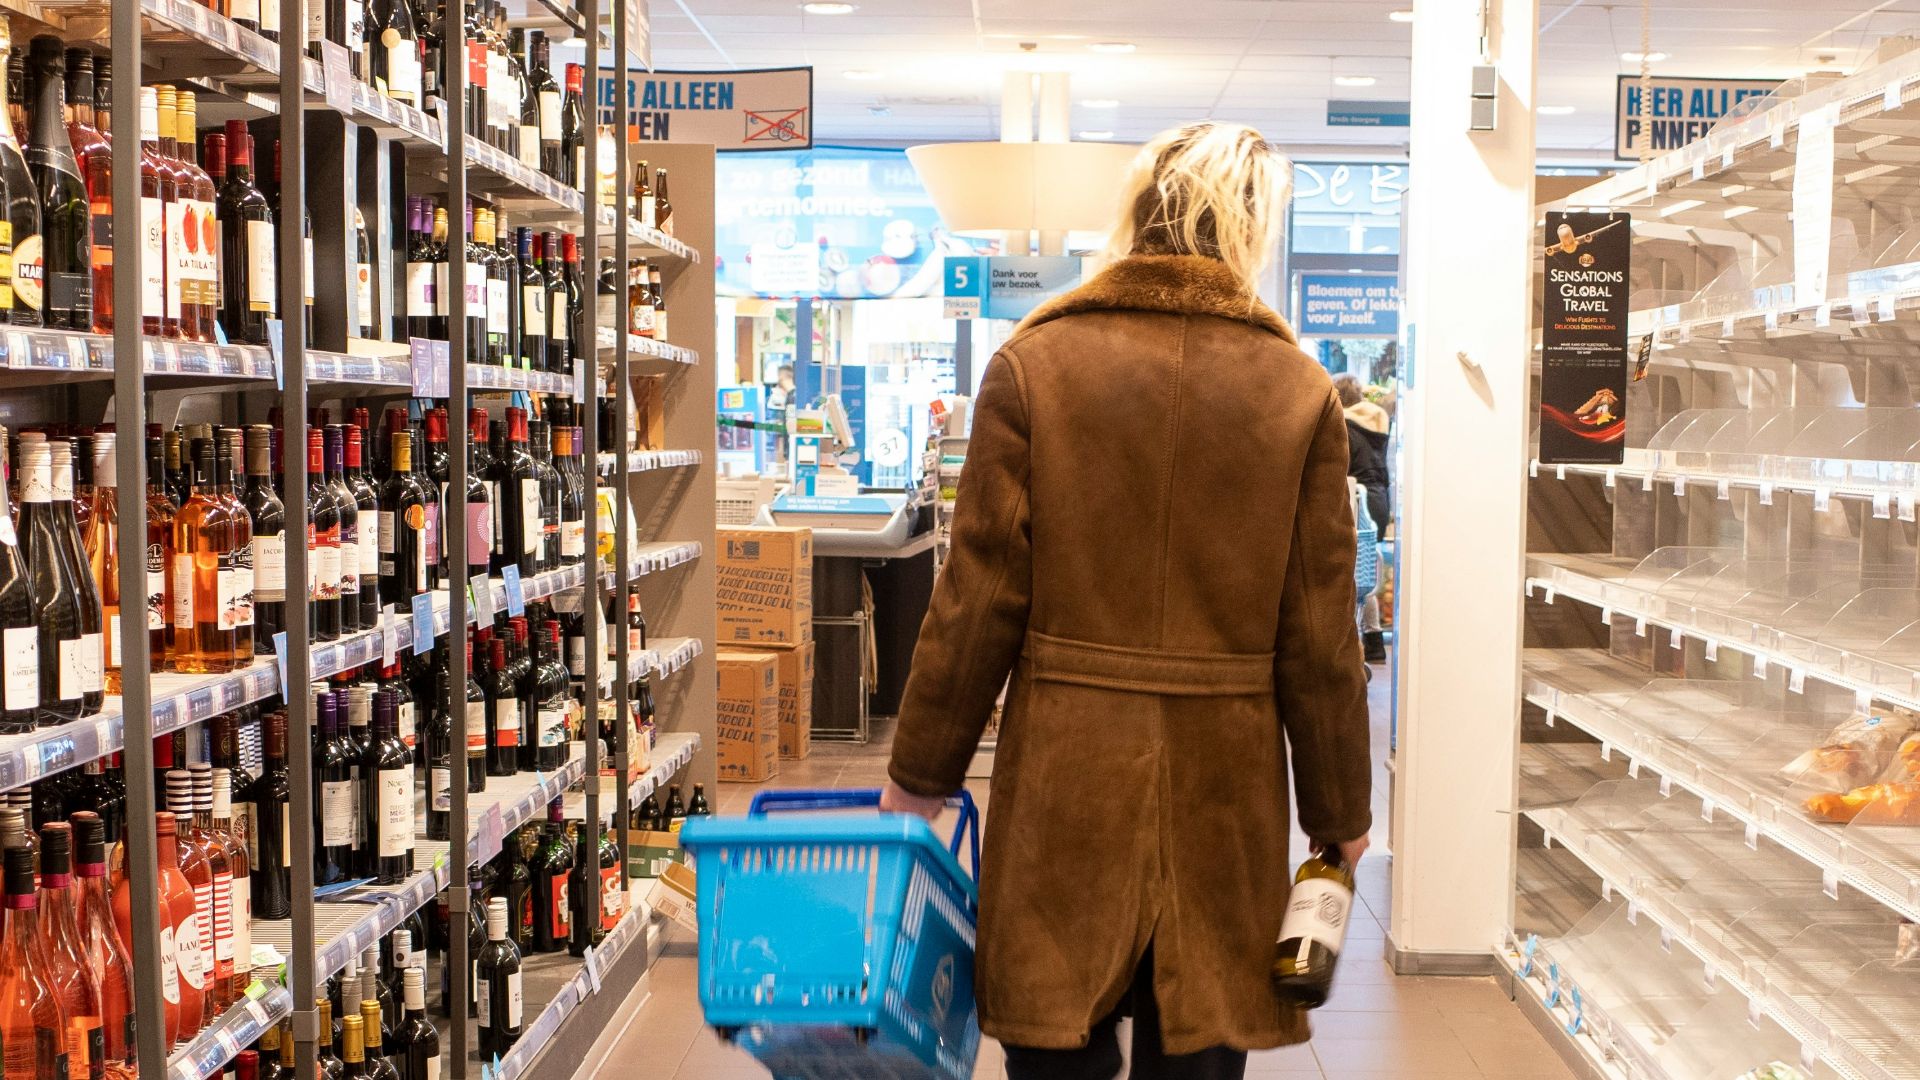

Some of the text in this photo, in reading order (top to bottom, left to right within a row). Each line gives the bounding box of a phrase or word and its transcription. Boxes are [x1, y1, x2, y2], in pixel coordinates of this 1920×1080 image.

[641, 80, 734, 110] ALLEEN
[954, 265, 969, 289] 5
[992, 269, 1015, 278] Dank
[1550, 269, 1623, 283] SENSATIONS
[992, 280, 1043, 289] uw bezoek.
[1307, 284, 1363, 297] Bloemen
[1366, 287, 1386, 297] om
[1560, 283, 1612, 297] GLOBAL
[1307, 299, 1347, 313] geven.
[1351, 299, 1367, 310] Of
[1563, 298, 1609, 312] TRAVEL
[1307, 311, 1376, 327] voor jezelf.
